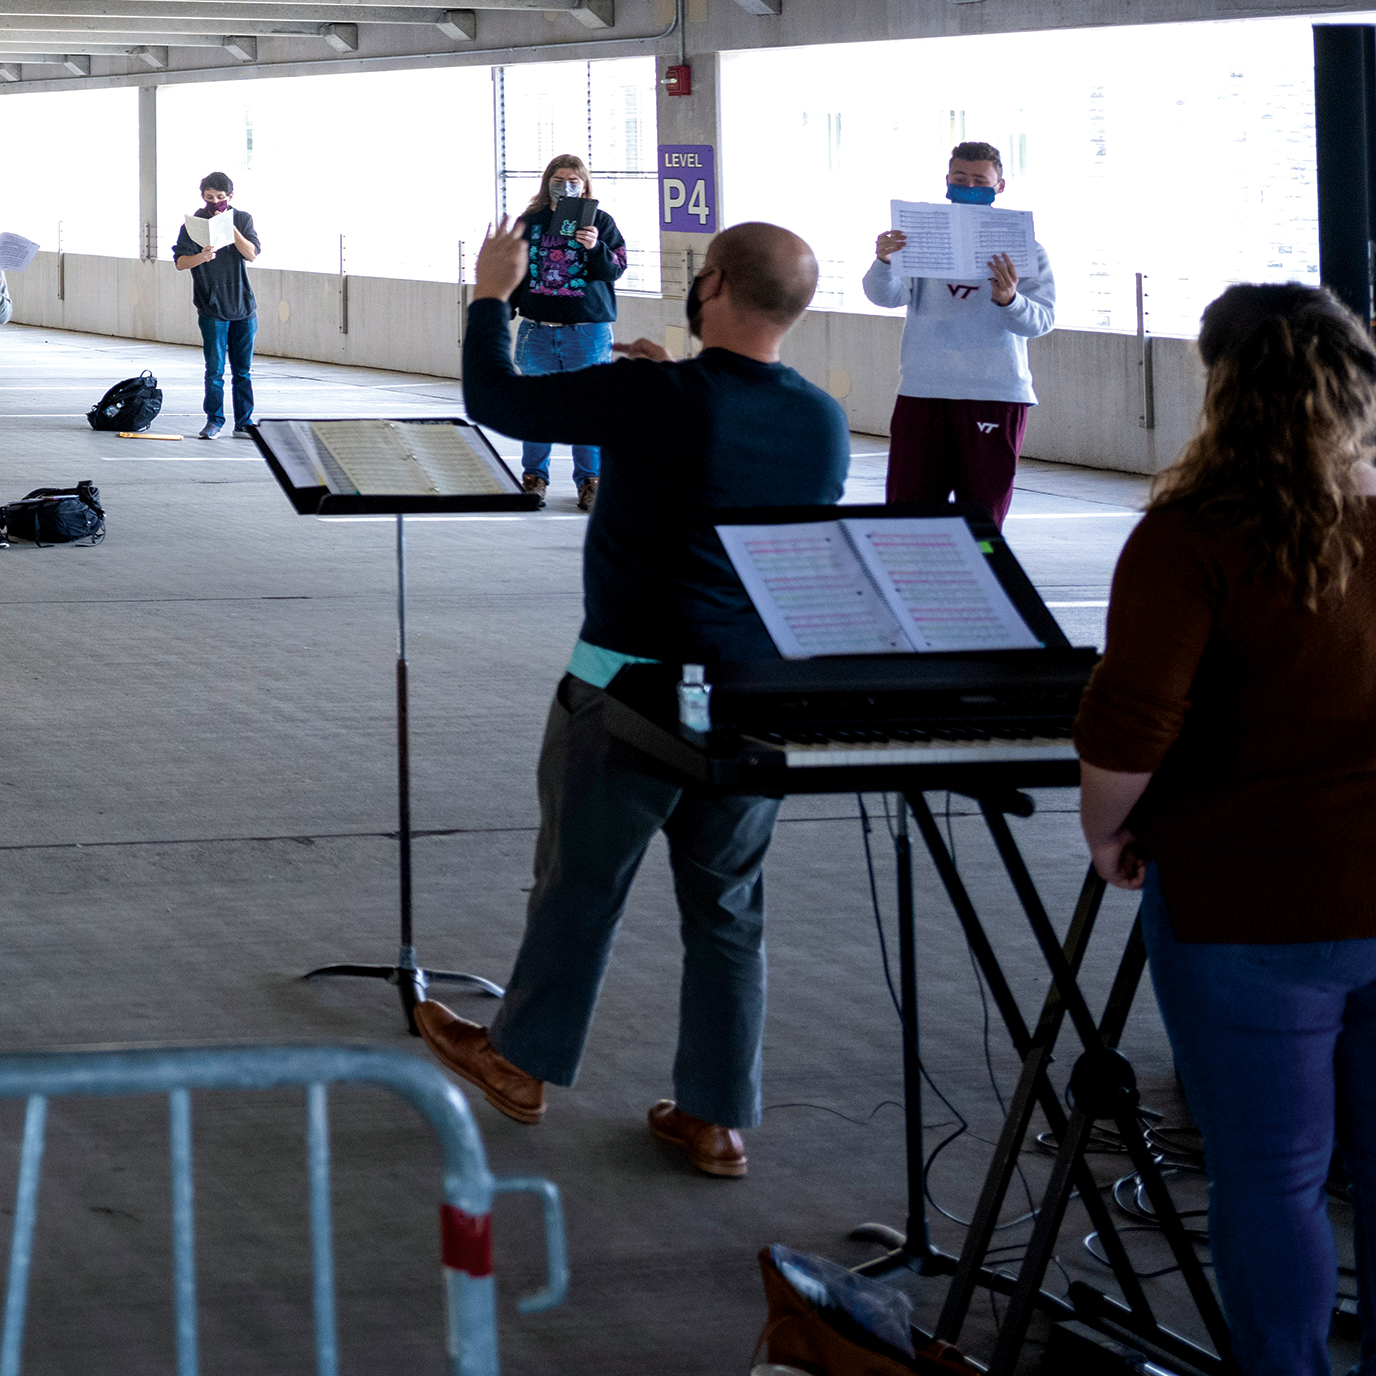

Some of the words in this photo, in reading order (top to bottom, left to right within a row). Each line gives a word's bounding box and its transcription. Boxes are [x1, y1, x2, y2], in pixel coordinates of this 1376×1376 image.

[664, 153, 702, 167] LEVEL
[663, 178, 710, 225] P4
[946, 283, 981, 300] VT
[976, 421, 1000, 434] VT
